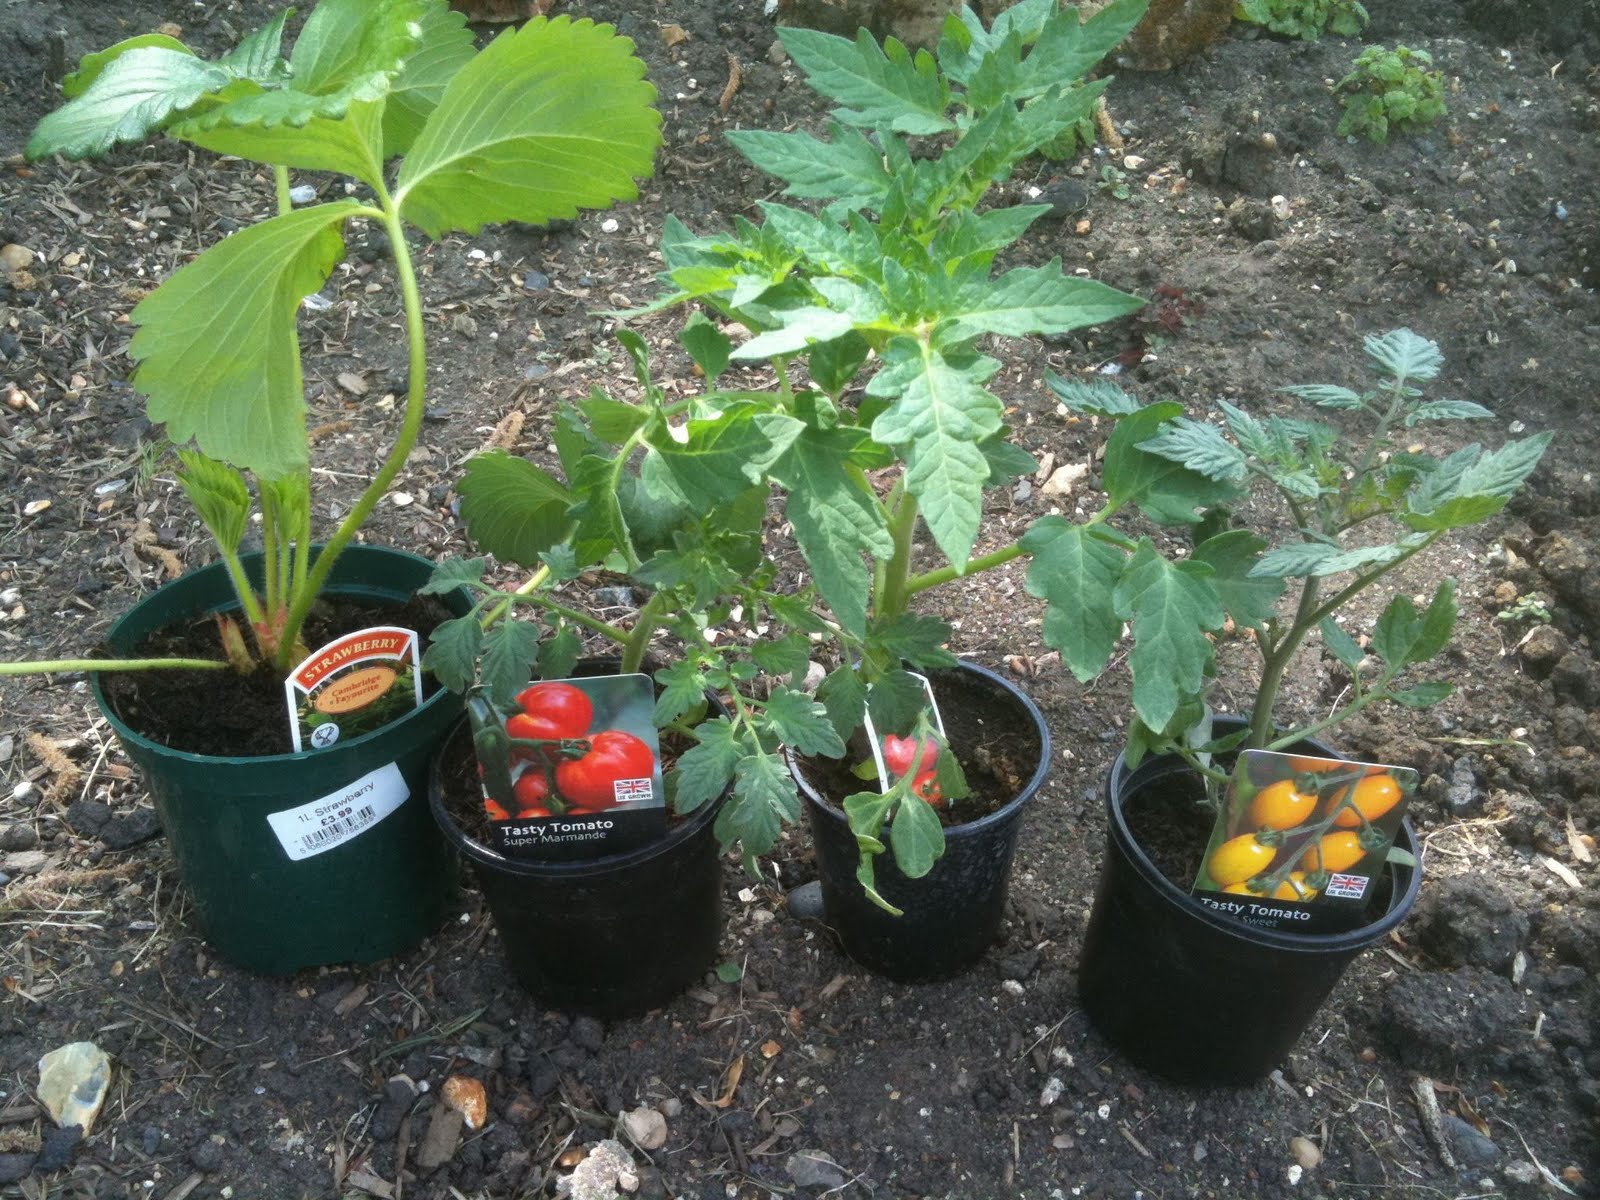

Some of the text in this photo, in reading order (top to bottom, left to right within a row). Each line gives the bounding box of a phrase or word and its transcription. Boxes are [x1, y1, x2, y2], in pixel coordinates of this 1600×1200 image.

[304, 638, 399, 681] STRAWBERRY
[331, 675, 381, 697] Cambridge
[315, 781, 375, 817] Strawberry
[320, 807, 353, 827] £3.99
[501, 820, 614, 836] Tasty Tomato
[503, 831, 607, 847] Super Marmande
[1337, 890, 1361, 898] GROWN
[1249, 903, 1311, 921] Tomato
[1242, 915, 1279, 928] Sweet
